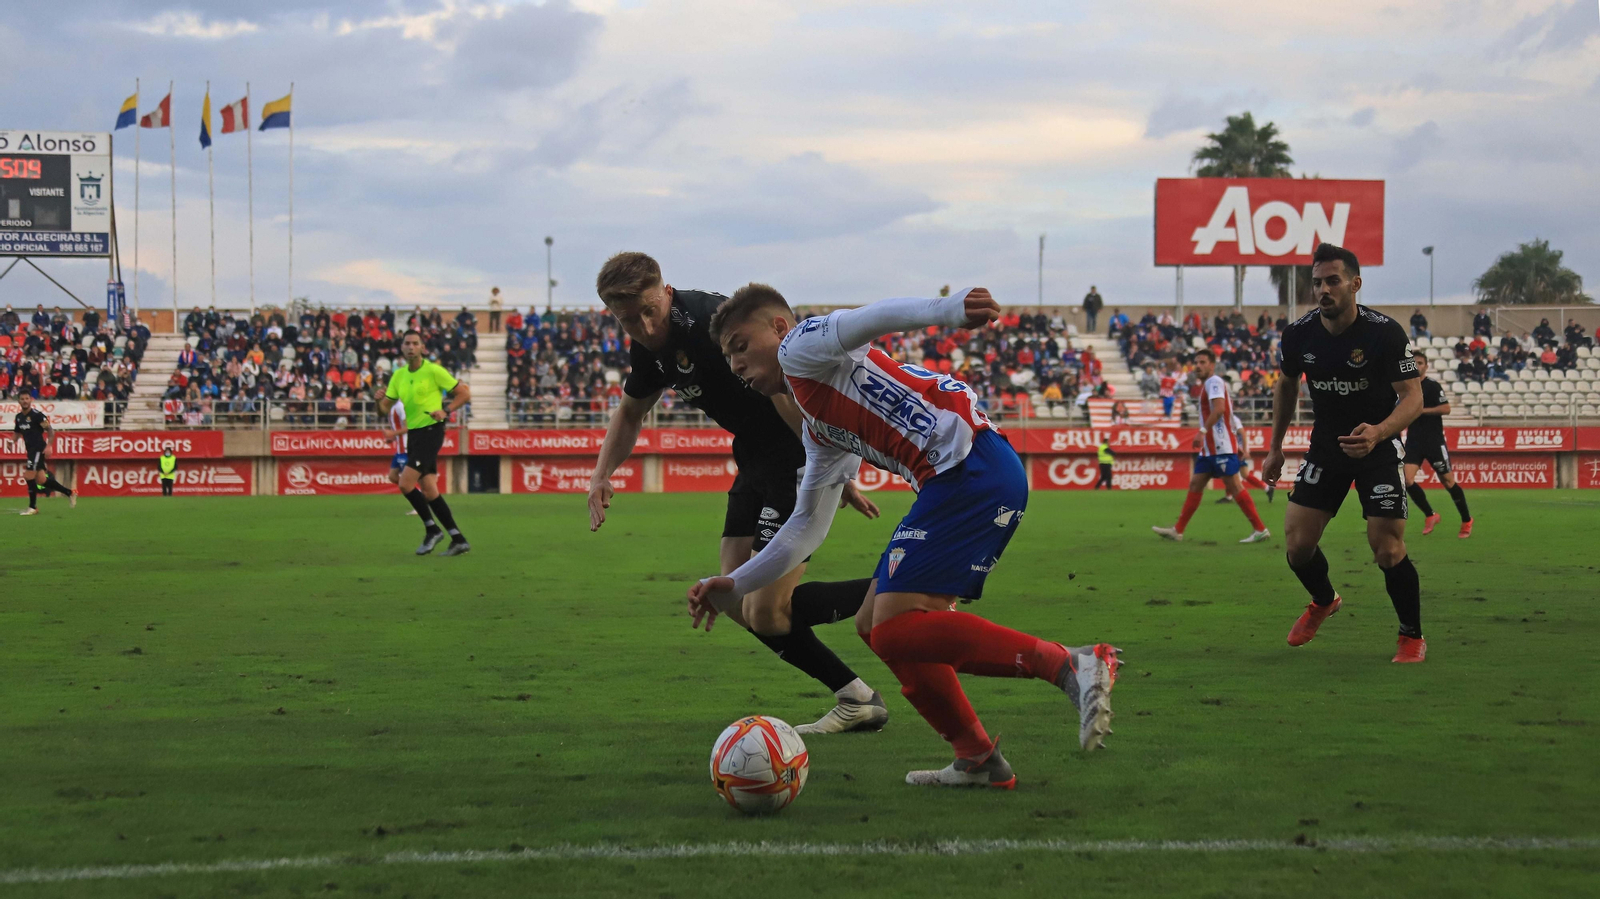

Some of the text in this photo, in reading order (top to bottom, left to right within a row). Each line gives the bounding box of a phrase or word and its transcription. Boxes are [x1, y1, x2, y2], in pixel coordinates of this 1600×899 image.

[17, 133, 96, 152] Alonso
[29, 187, 65, 197] VISITANTE
[0, 219, 32, 227] ERIODO
[1190, 186, 1351, 256] AON
[21, 232, 81, 243] ALGECIRAS
[83, 233, 103, 243] S.L.
[13, 243, 50, 252] OFICIAL
[58, 243, 73, 252] 956
[89, 243, 103, 252] 167
[860, 375, 932, 431] ZPMC
[56, 437, 85, 454] RFEF
[110, 436, 192, 453] Footters
[1457, 435, 1505, 445] APOLO
[1515, 435, 1563, 445] APOLO
[1111, 456, 1174, 472] onzález
[1478, 461, 1489, 471] de
[1491, 461, 1548, 471] Construcción
[668, 464, 724, 478] Hospital
[1048, 458, 1096, 486] GG
[1429, 471, 1548, 484] AUA MARINA
[557, 479, 570, 490] de
[1111, 473, 1168, 490] aggero
